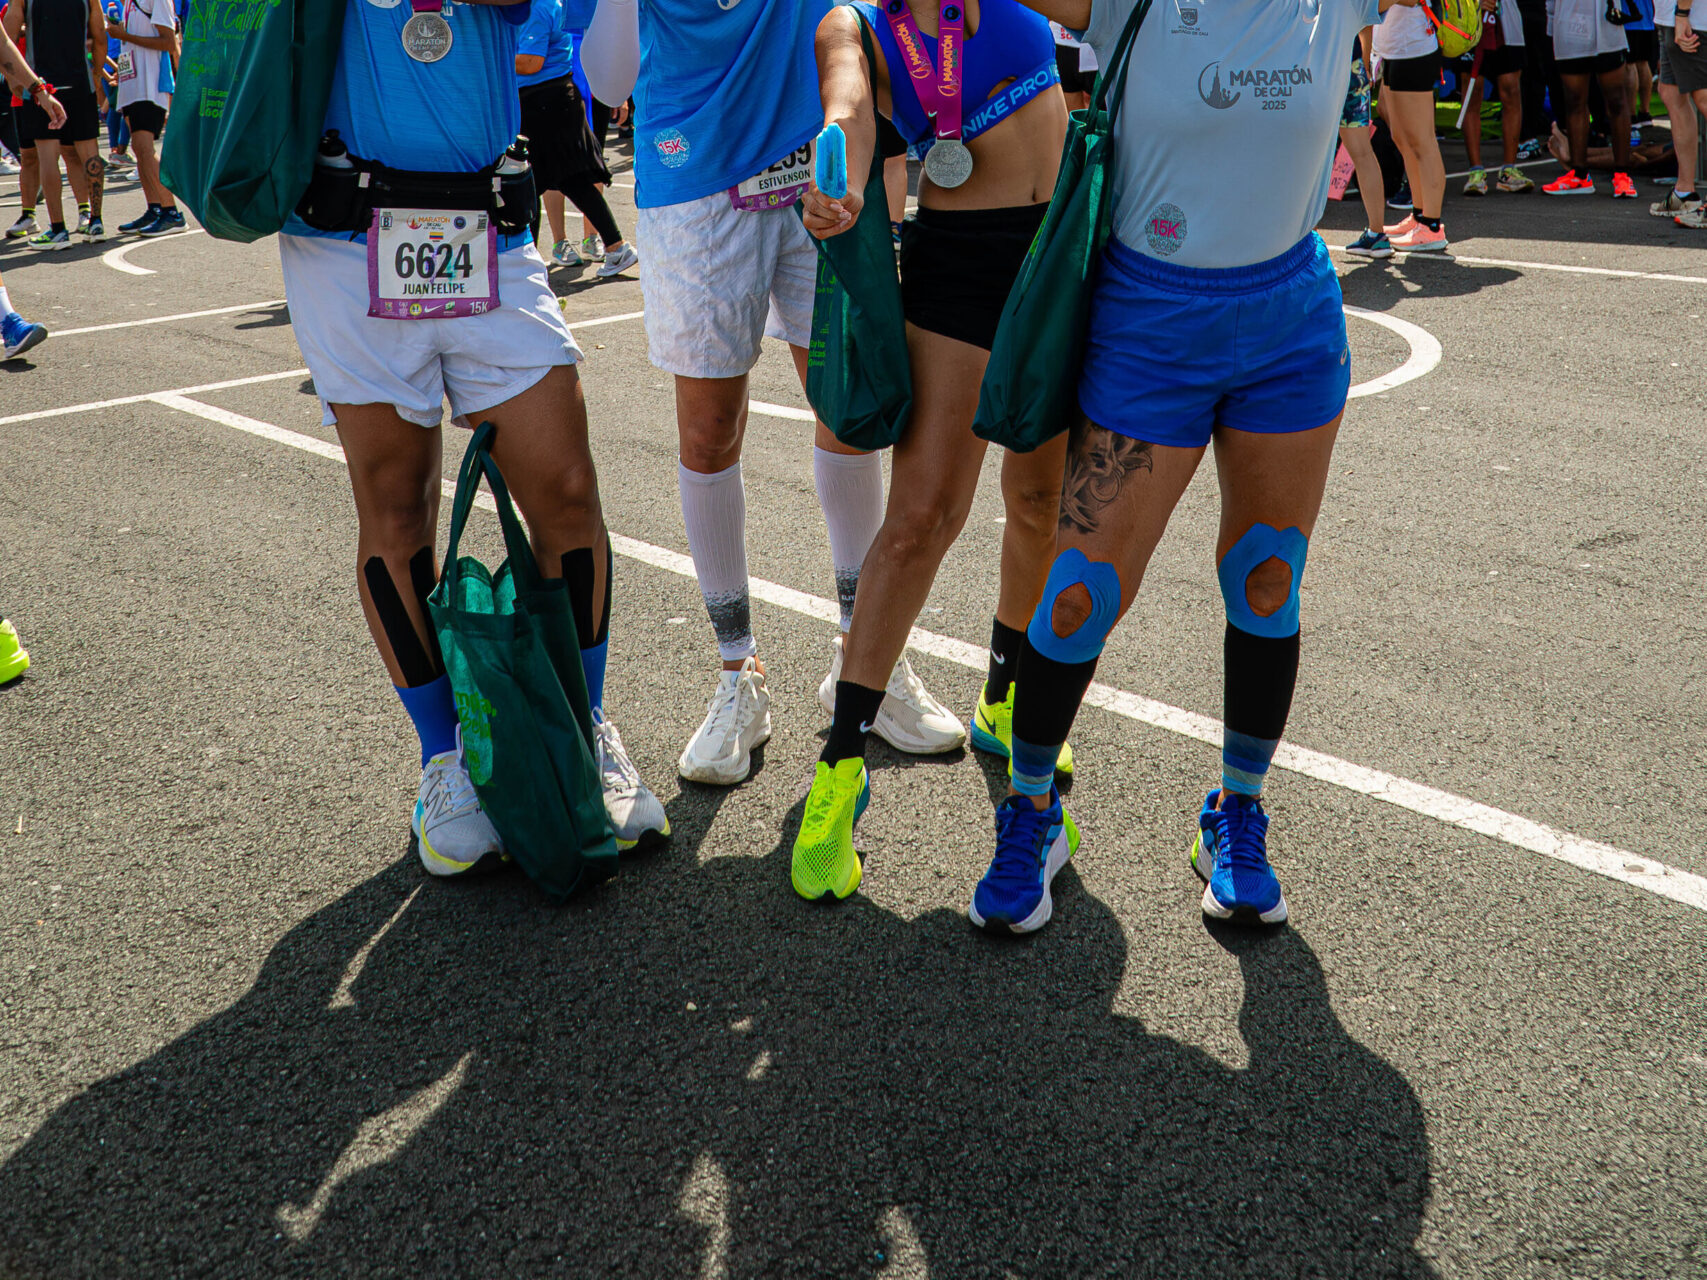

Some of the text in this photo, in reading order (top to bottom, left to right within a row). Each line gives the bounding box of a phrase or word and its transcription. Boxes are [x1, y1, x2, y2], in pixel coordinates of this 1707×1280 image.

[941, 34, 953, 82] MARATÓN
[1229, 64, 1312, 86] MARATÓN
[1254, 86, 1292, 97] DE CALI
[962, 71, 1048, 138] NIKE PRO
[1262, 100, 1286, 110] 2025
[658, 138, 685, 155] 15K
[759, 169, 811, 190] ESTIVENSON
[418, 216, 450, 224] MARATÓN
[1152, 219, 1180, 240] 15K
[395, 242, 473, 278] 6624
[403, 283, 465, 295] JUAN FELIPE
[469, 301, 488, 314] 15K
